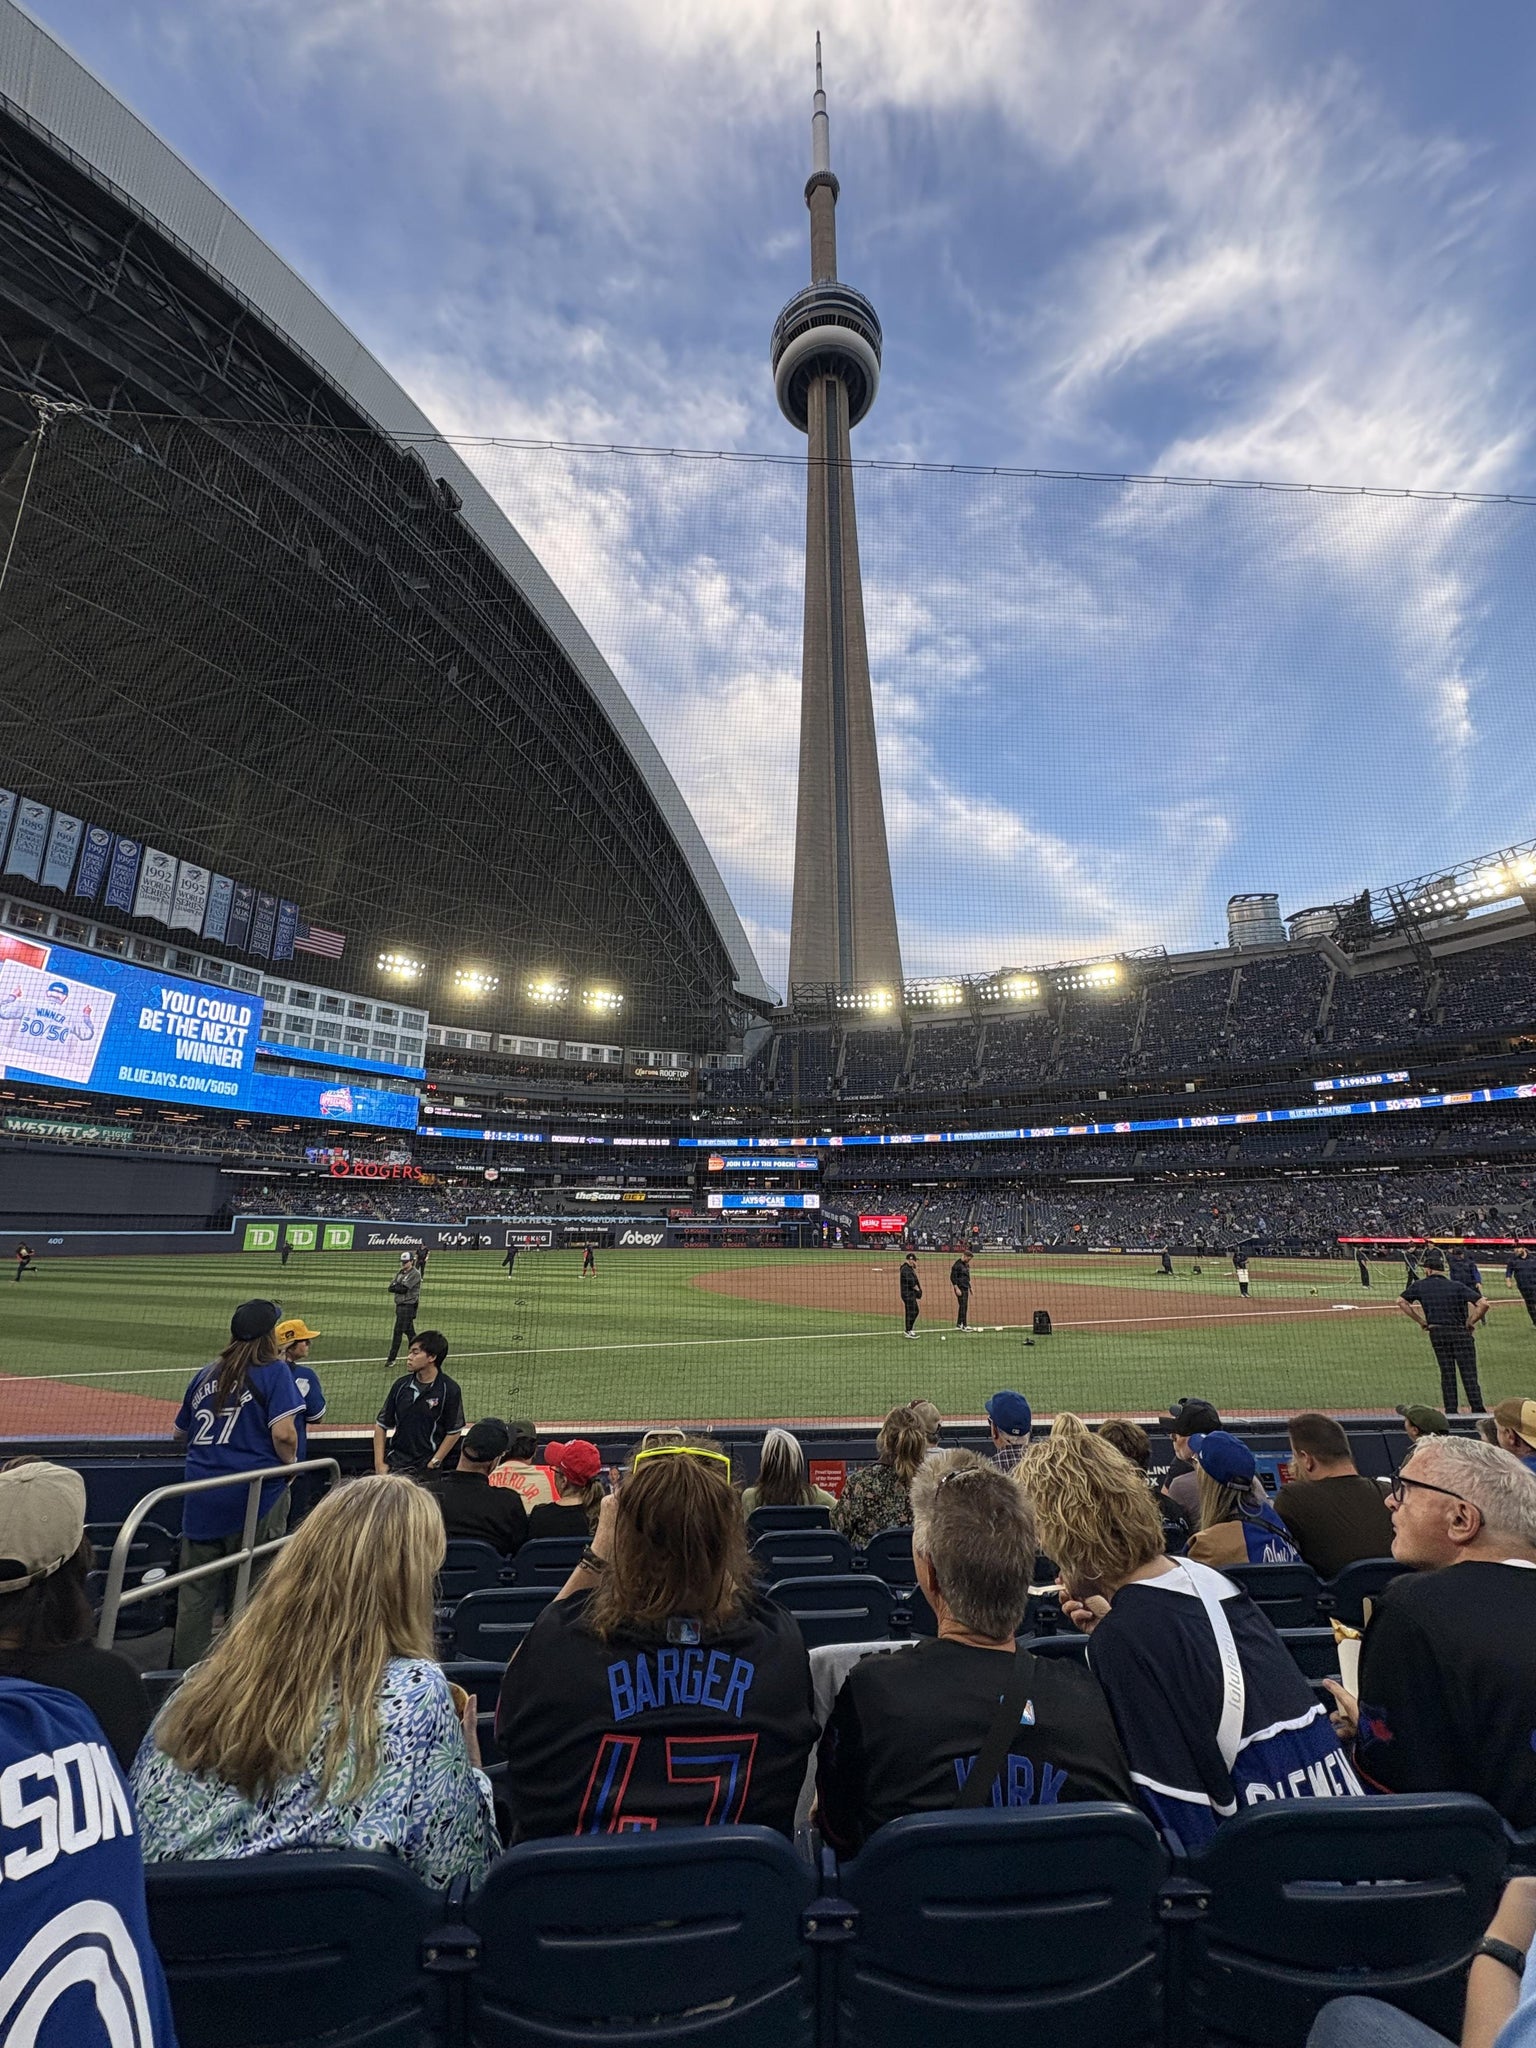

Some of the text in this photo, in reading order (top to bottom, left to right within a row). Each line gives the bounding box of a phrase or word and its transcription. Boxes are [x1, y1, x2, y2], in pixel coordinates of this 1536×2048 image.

[21, 818, 44, 831] 1989
[56, 832, 75, 844] 1991
[146, 866, 172, 883] 1992
[141, 884, 170, 899] SERIES
[144, 878, 171, 892] WORLD
[181, 878, 206, 896] 1993
[176, 897, 204, 911] SERIES
[178, 890, 204, 904] WORLD
[161, 988, 251, 1027] YOU COULD
[36, 1008, 66, 1024] WINNER
[138, 1008, 248, 1048] BE THE NEXT
[176, 1038, 244, 1070] WINNER
[118, 1066, 238, 1096] BLUEJAYS.COM/5050
[634, 1068, 689, 1078] Corona ROOFTOP
[102, 1130, 132, 1139] FLIGHT
[354, 1162, 422, 1179] ROGERS
[575, 1192, 621, 1200] theScore
[741, 1196, 759, 1204] JAYS
[766, 1196, 785, 1204] CARE
[249, 1229, 274, 1246] TD
[289, 1229, 313, 1245] TD
[327, 1230, 349, 1245] TD
[368, 1233, 422, 1245] Tim Hortons
[438, 1232, 492, 1245] Kuboa
[620, 1230, 664, 1246] Sobeys
[192, 1380, 238, 1410] GUERRO
[193, 1407, 241, 1445] 27
[488, 1466, 526, 1490] RRERO
[607, 1648, 755, 1722] BARGER
[0, 1742, 133, 1882] SON
